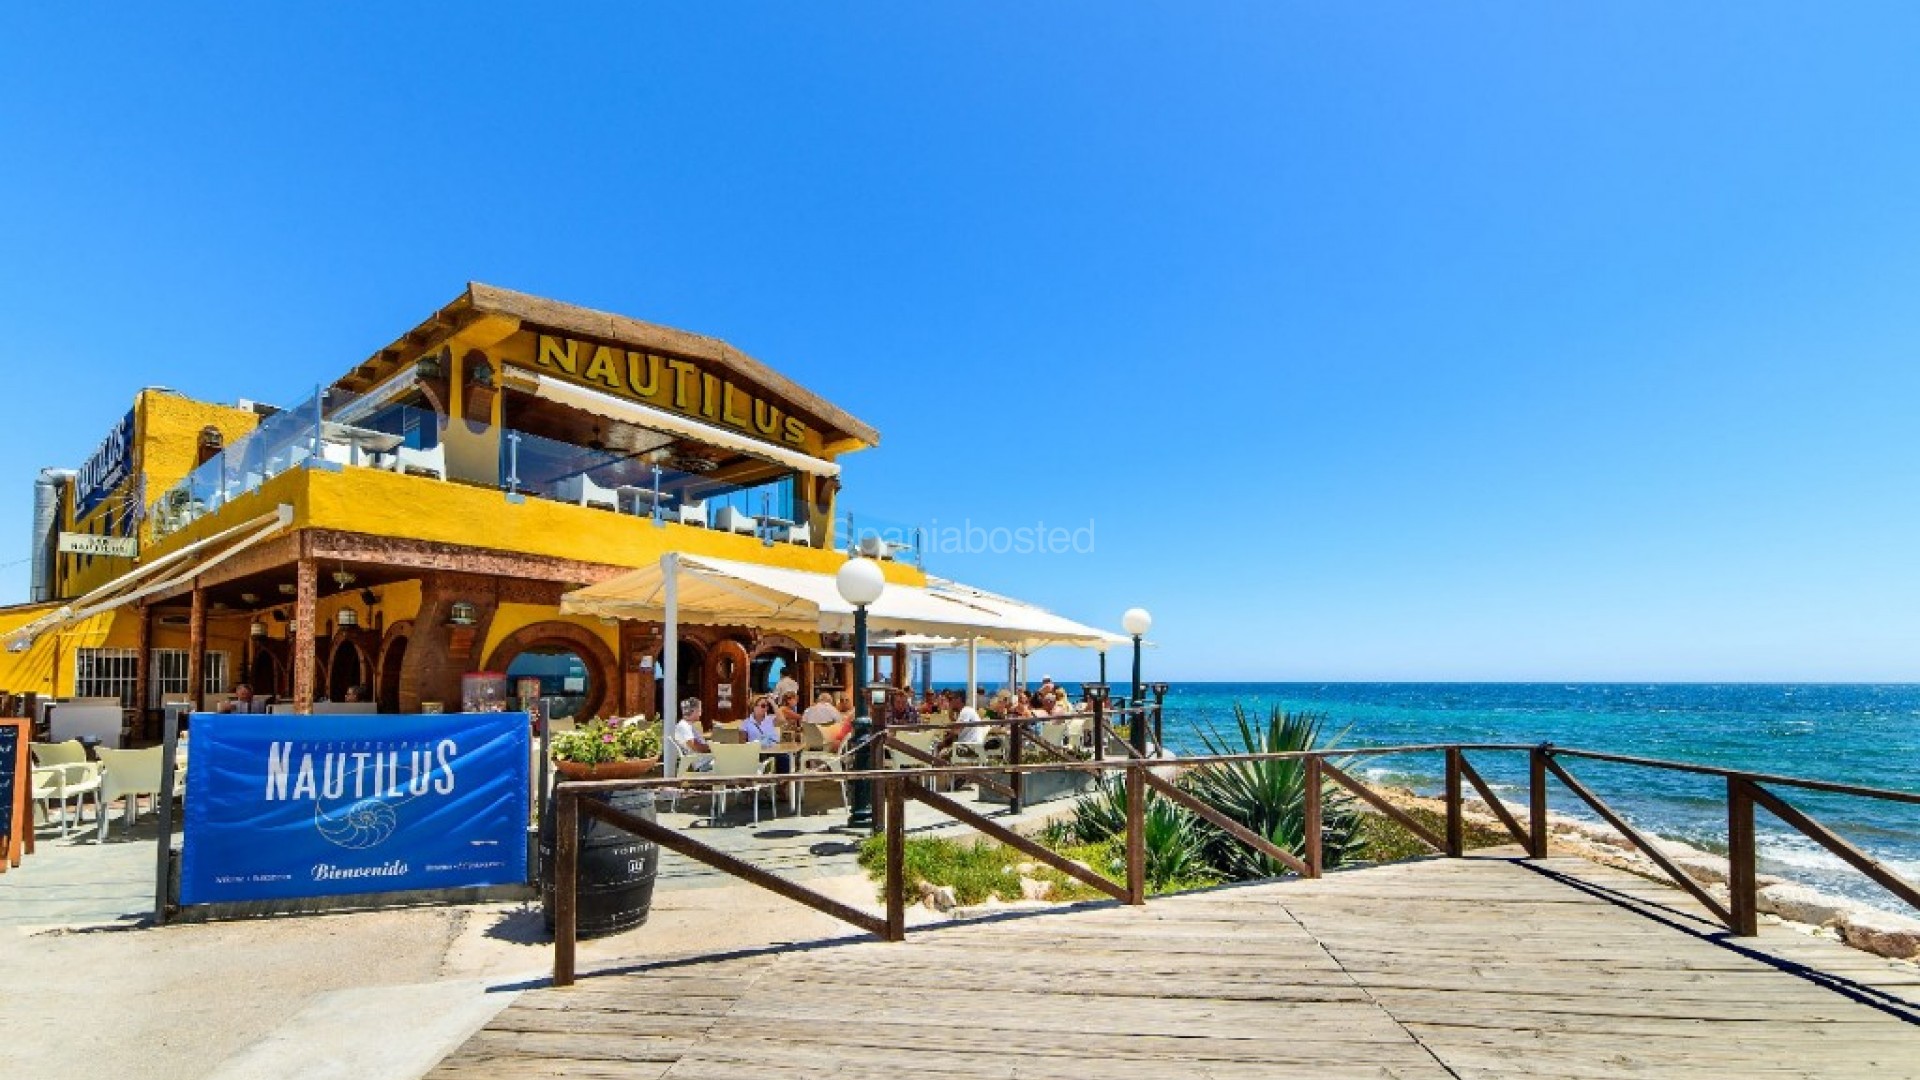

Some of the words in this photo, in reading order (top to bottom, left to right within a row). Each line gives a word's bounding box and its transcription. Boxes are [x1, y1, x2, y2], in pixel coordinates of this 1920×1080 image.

[537, 334, 805, 442] NAUTILUS
[265, 739, 457, 801] NAUTILUS
[311, 860, 408, 881] Bienvenido
